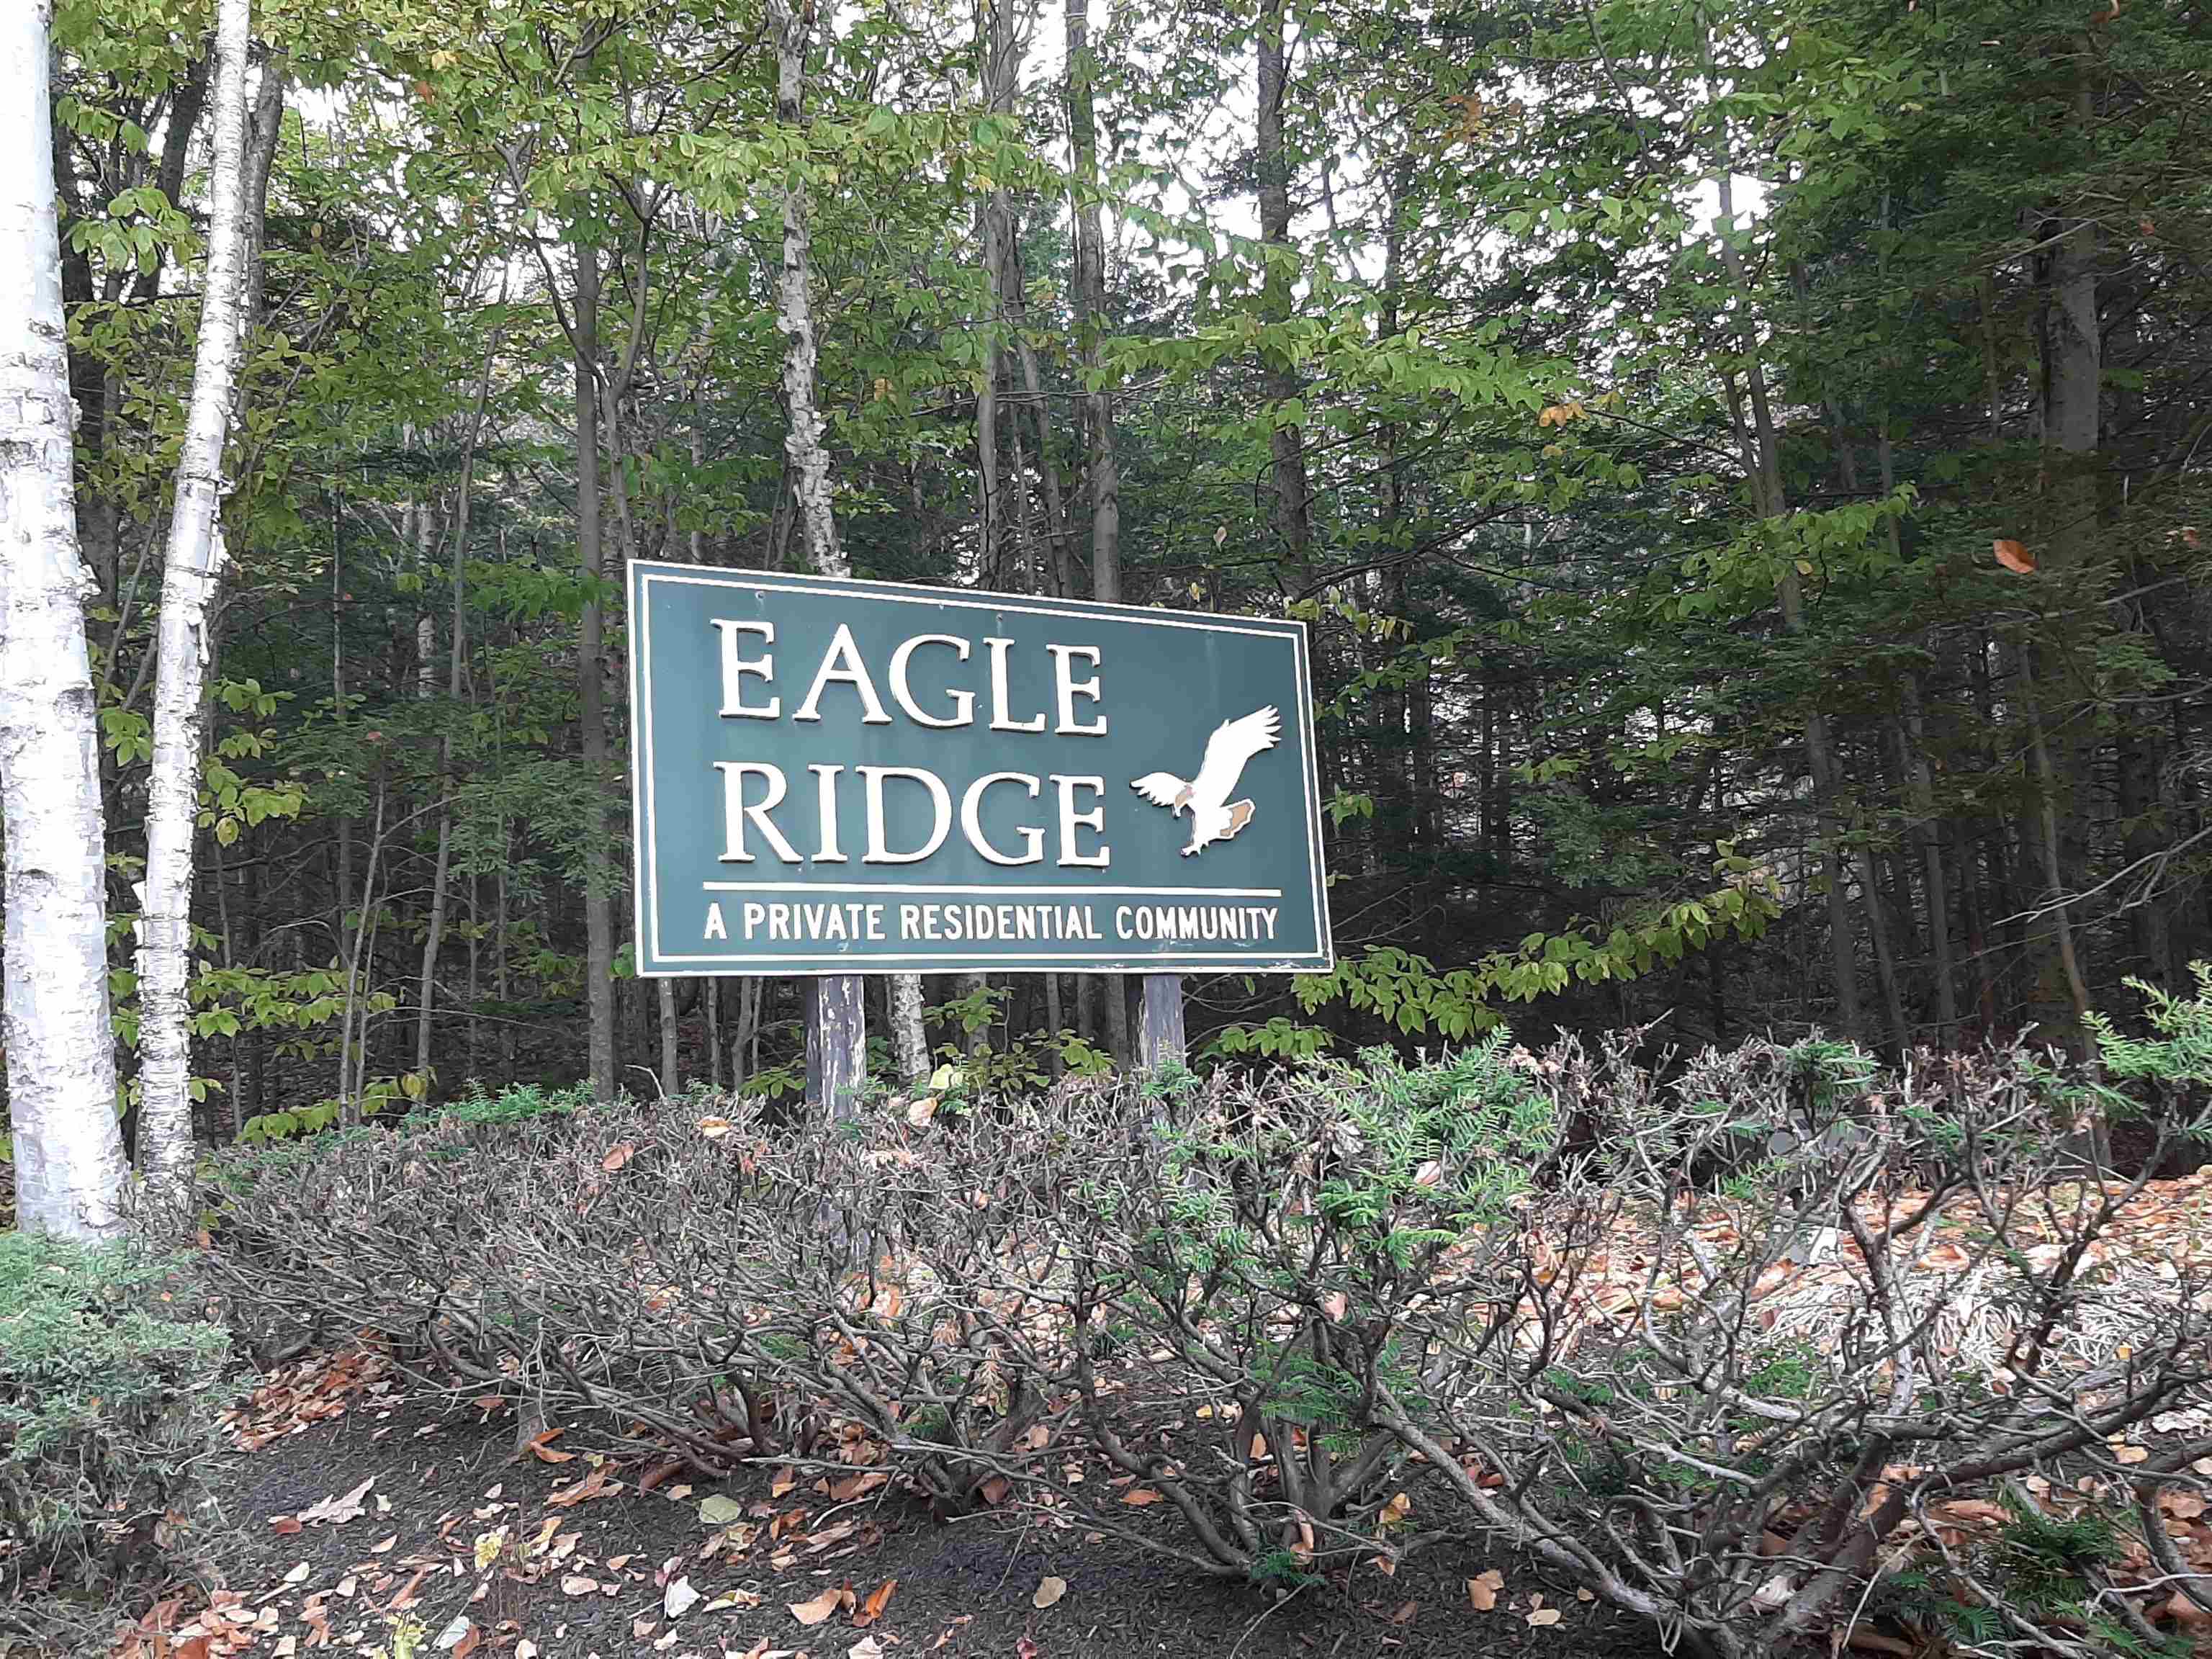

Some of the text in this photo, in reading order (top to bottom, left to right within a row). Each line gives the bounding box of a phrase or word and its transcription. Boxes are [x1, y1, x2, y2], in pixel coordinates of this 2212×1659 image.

[709, 618, 1108, 736] EAGLE
[712, 761, 1111, 868] RIDGE
[702, 902, 1279, 941] A PRIVATE RESIDENTIAL COMMUNITY
